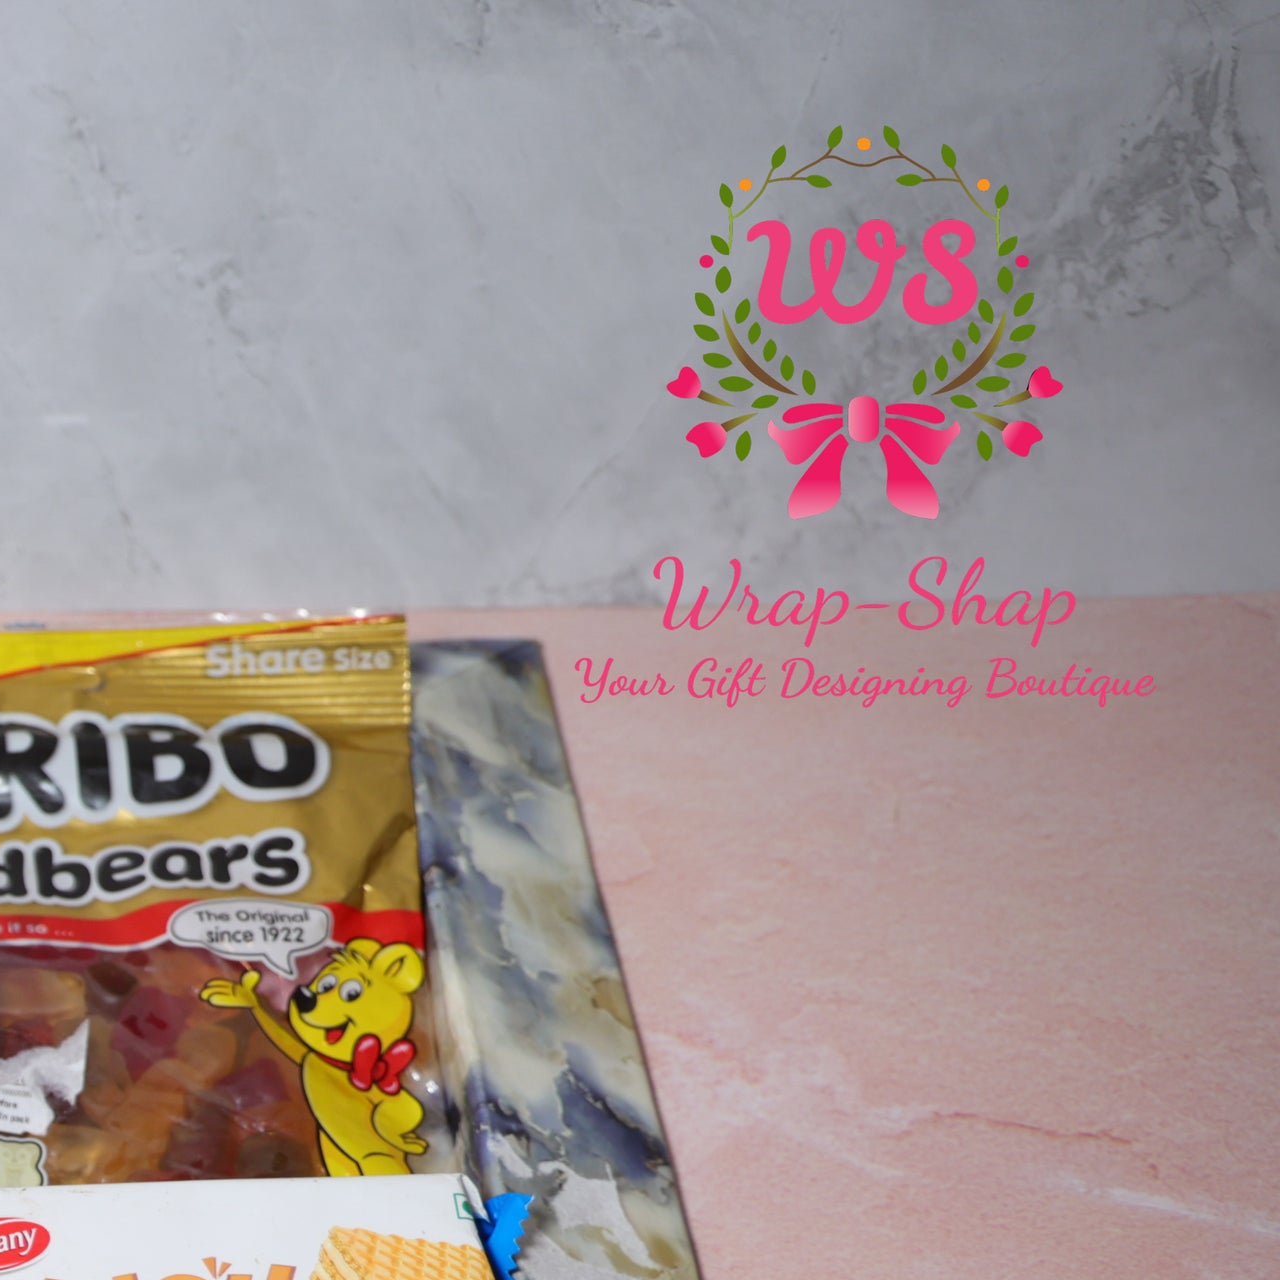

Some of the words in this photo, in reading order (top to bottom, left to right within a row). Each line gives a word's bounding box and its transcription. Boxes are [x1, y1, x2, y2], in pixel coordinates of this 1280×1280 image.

[205, 641, 326, 678] Share
[333, 648, 394, 671] Size
[195, 910, 231, 923] The
[236, 909, 311, 925] Original
[206, 927, 254, 944] since
[260, 927, 306, 943] 1922
